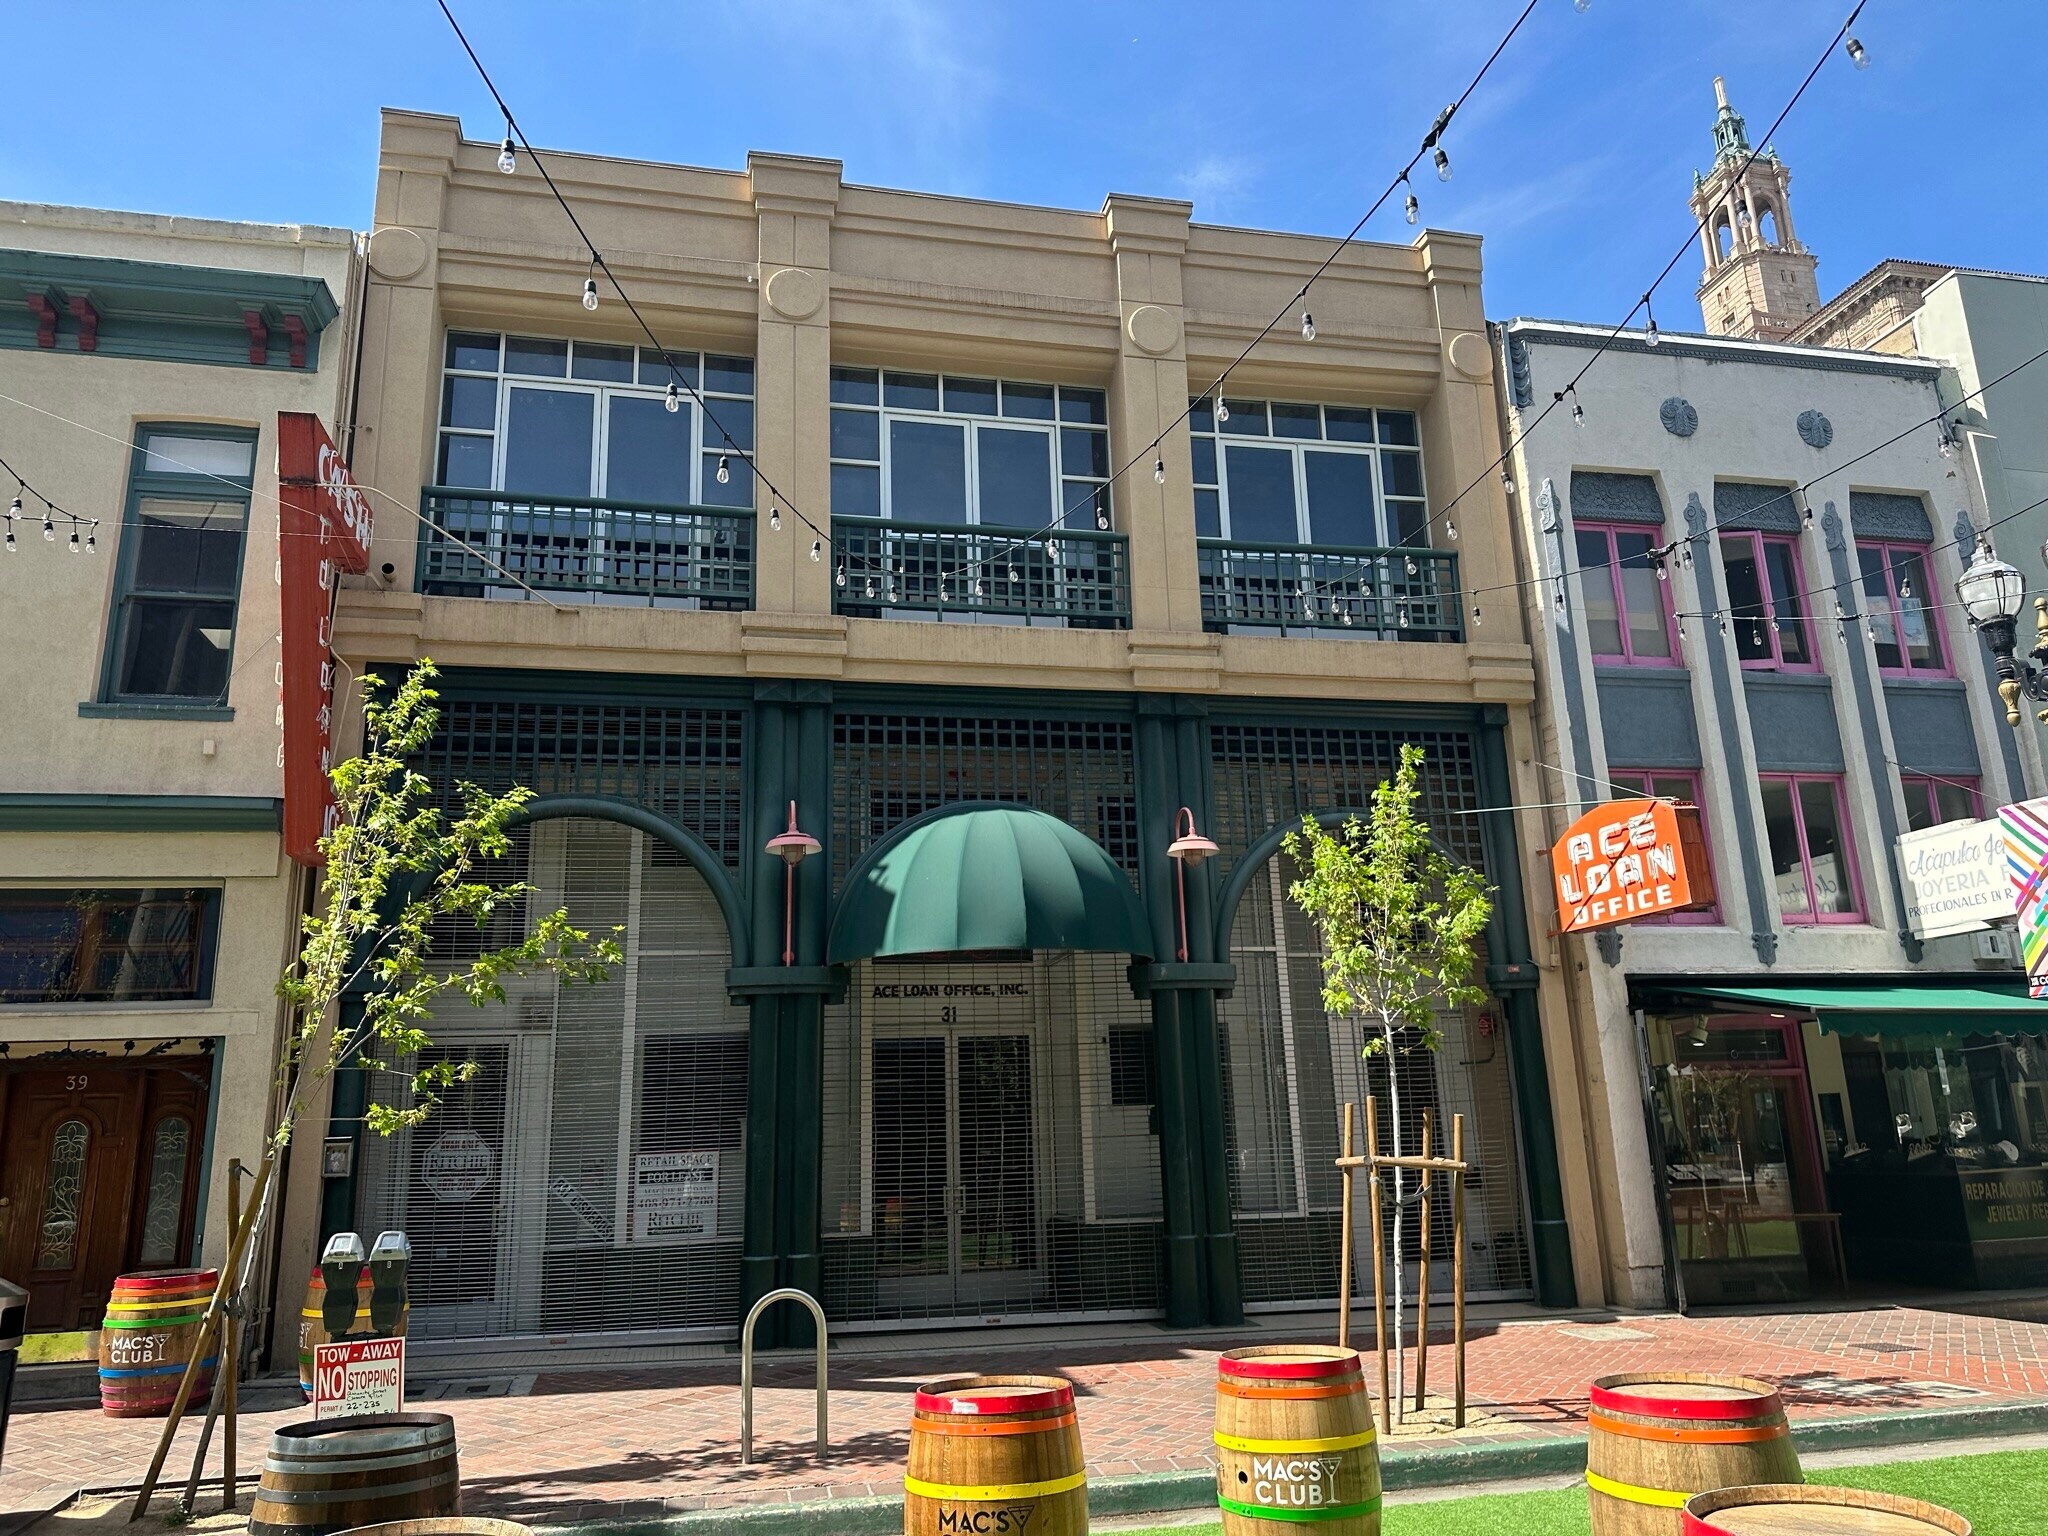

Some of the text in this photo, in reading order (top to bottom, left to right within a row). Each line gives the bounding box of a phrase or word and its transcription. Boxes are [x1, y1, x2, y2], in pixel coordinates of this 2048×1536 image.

[317, 443, 374, 551] CASH
[1567, 812, 1657, 865] ACE
[1909, 833, 2006, 878] Acapulco Je
[1559, 843, 1676, 904] LOAN
[1914, 868, 1990, 900] JOYERIA
[1573, 884, 1673, 925] OFFICE
[1908, 892, 1987, 918] PROFECIONALES
[1991, 889, 2002, 901] EN
[872, 983, 1029, 998] ACE LOAN OFFICE, INC.
[941, 1006, 957, 1023] 31
[65, 1075, 88, 1090] 39
[430, 1154, 489, 1168] RITCHIE
[640, 1154, 714, 1167] RETAIL SPACE
[647, 1170, 706, 1184] FOR LEASE
[1965, 1180, 2046, 1201] REPARACION DE
[648, 1212, 703, 1226] RITCHIE
[1987, 1203, 2030, 1223] JEWELRY
[111, 1336, 154, 1350] MAC'S
[319, 1347, 351, 1363] TOW
[361, 1342, 400, 1360] AWAY
[110, 1350, 153, 1364] CLUB
[318, 1366, 397, 1399] NO STOPPING
[1253, 1456, 1322, 1482] MAC'S
[1254, 1480, 1323, 1505] CLUB
[938, 1507, 1010, 1534] MAC'S
